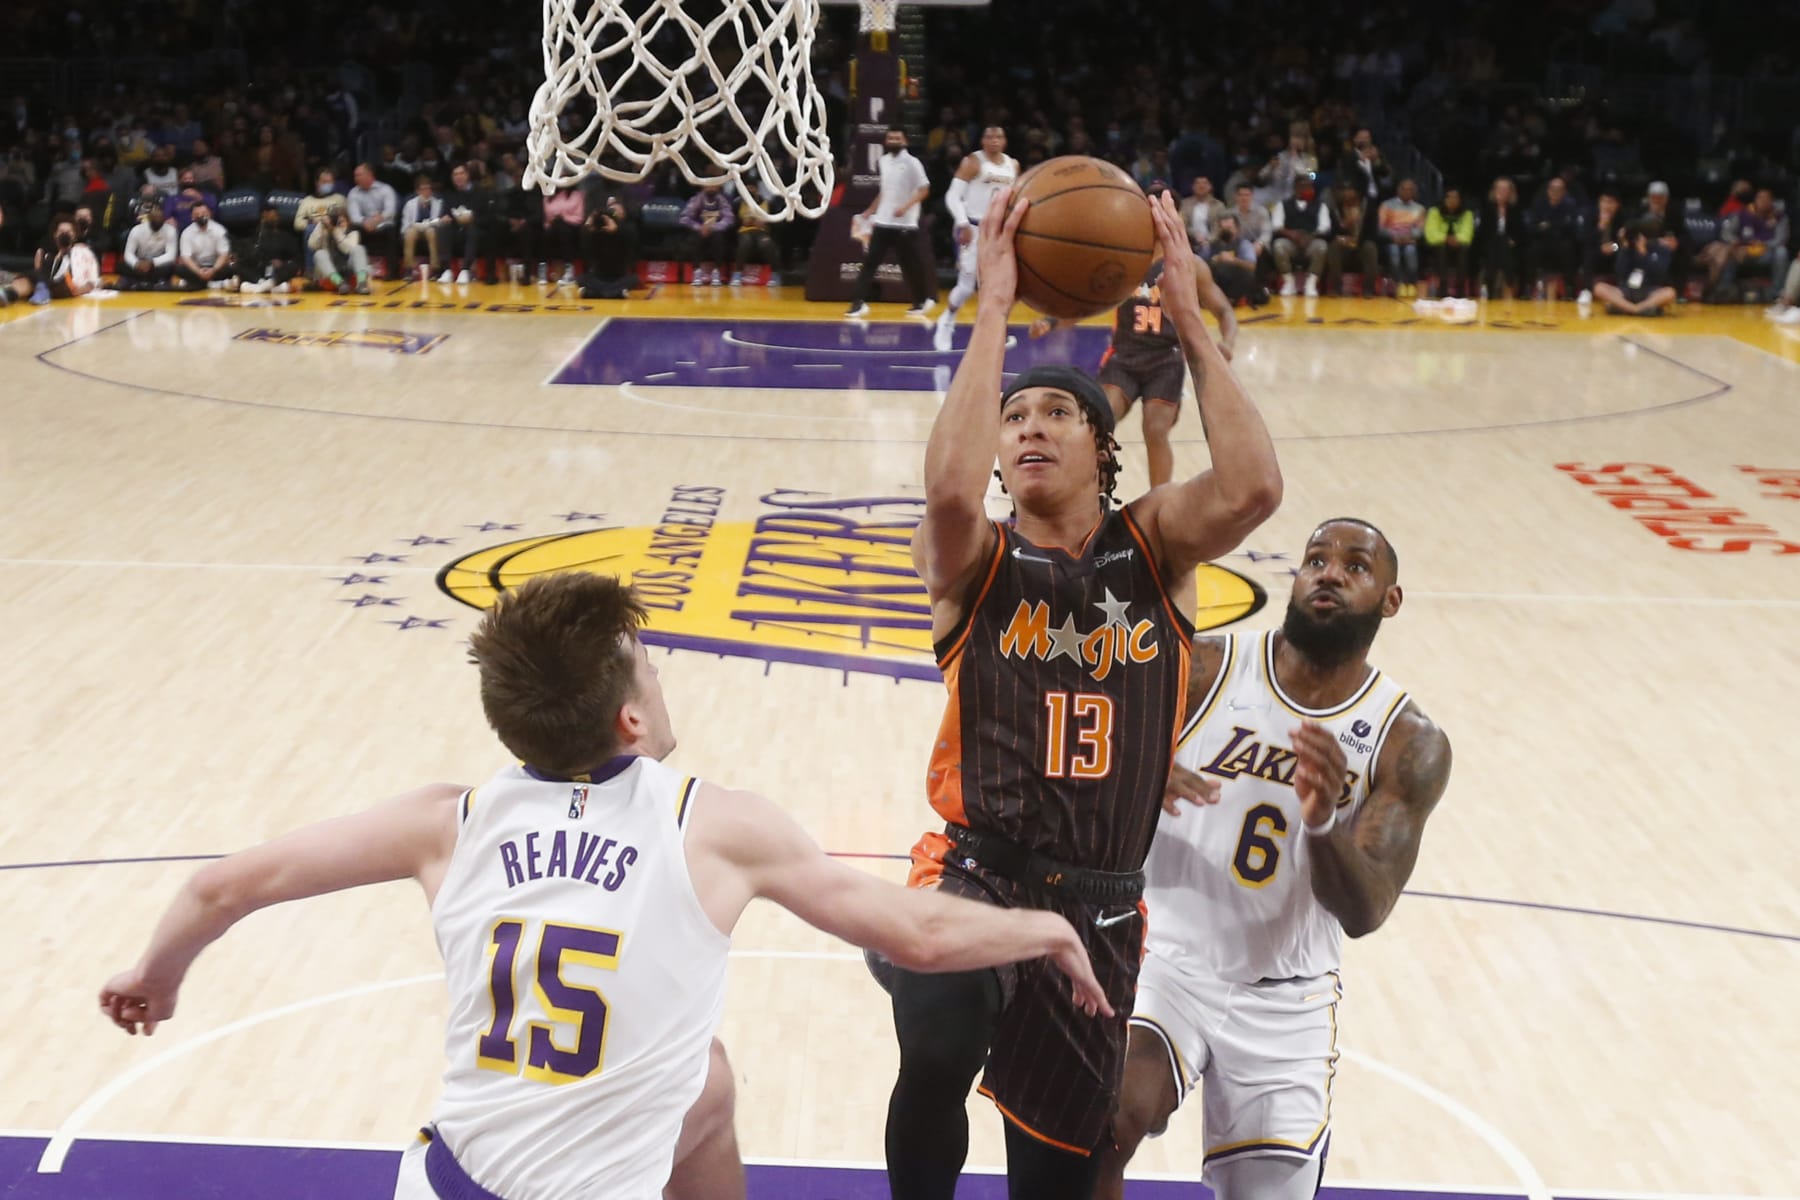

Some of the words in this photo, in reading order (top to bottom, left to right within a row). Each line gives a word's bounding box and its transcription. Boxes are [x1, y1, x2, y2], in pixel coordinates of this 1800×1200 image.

[1133, 304, 1162, 334] 34
[645, 484, 727, 568] ANGELES
[631, 569, 694, 611] LOS
[1044, 691, 1116, 779] 13
[1200, 726, 1360, 809] LAKS
[1339, 733, 1373, 754] bibigo
[500, 830, 638, 892] REAVES
[1231, 801, 1289, 889] 6
[476, 917, 625, 1086] 15
